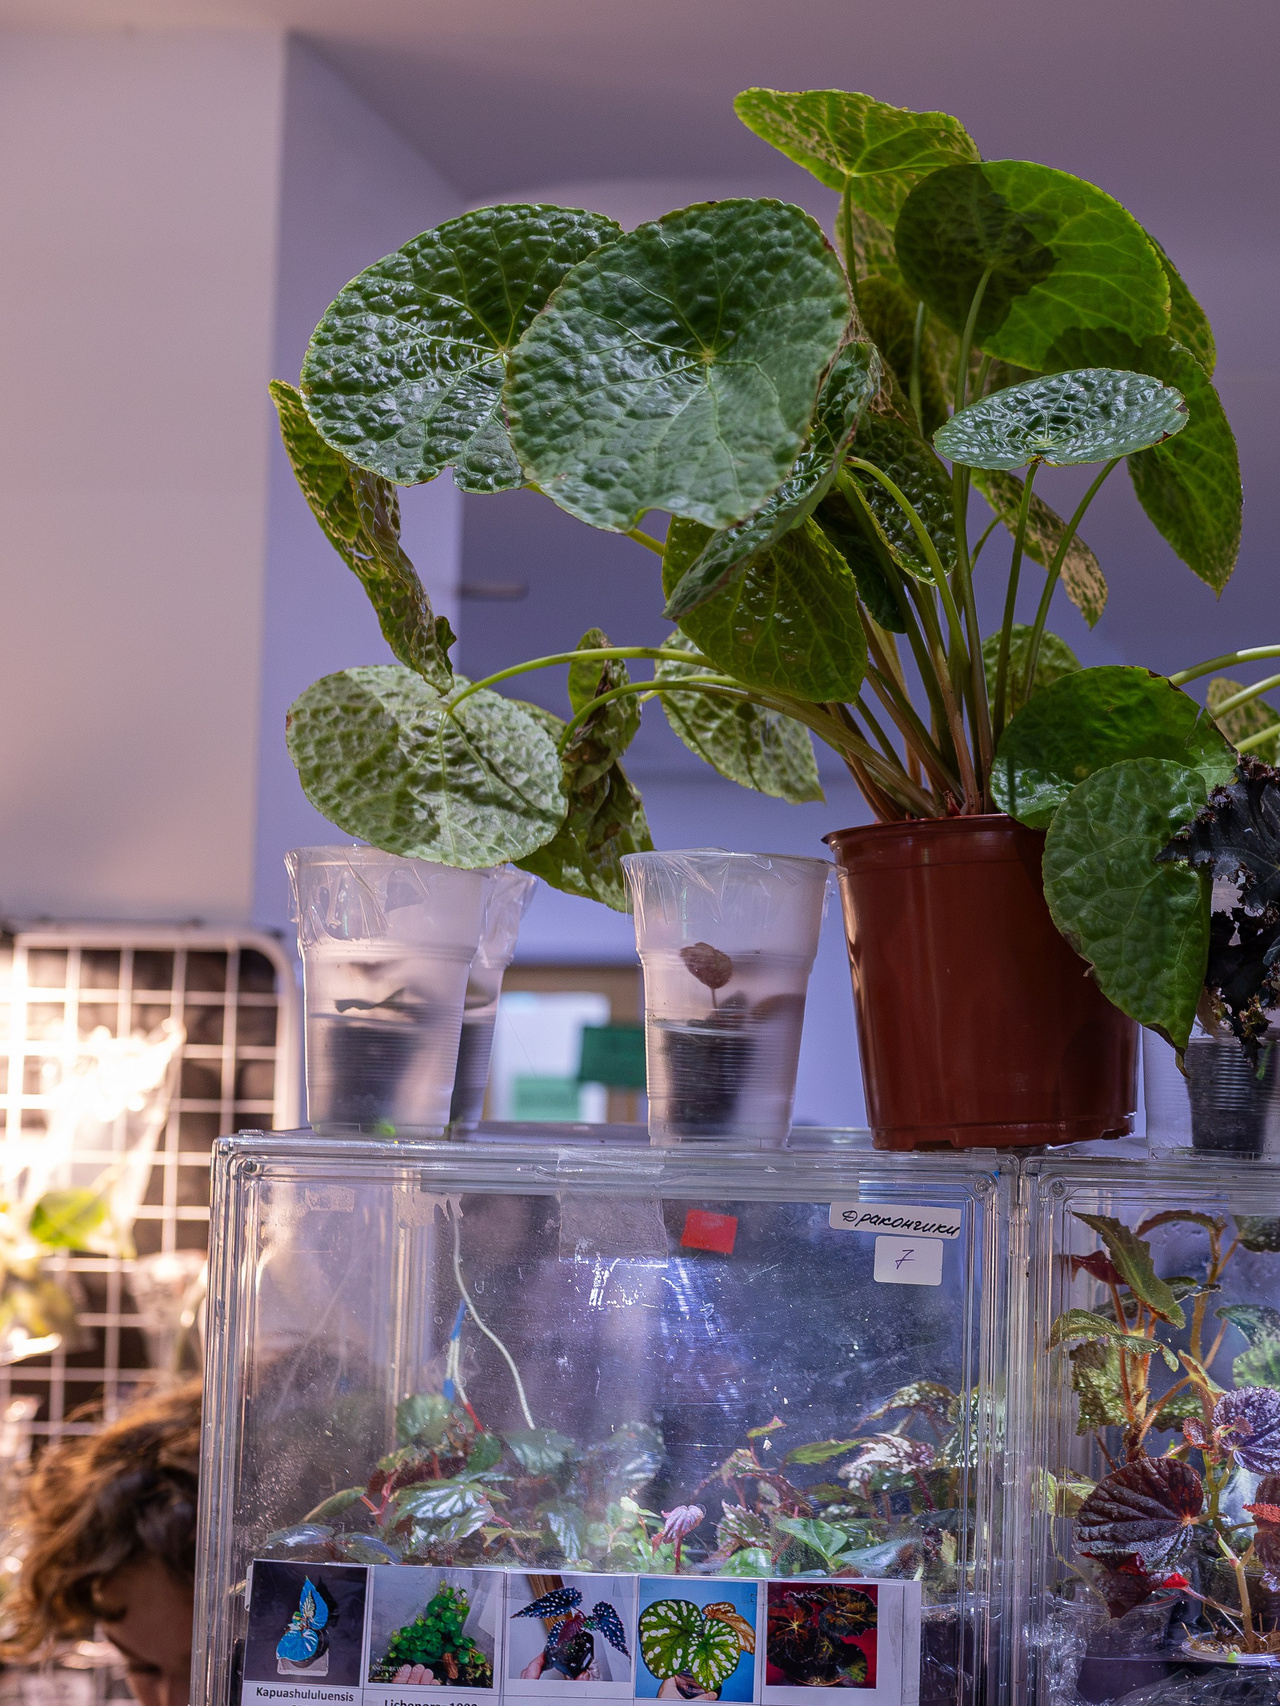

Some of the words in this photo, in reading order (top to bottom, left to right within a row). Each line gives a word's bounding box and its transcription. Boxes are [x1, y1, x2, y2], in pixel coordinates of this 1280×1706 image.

[842, 1210, 961, 1237] Дракончики
[894, 1249, 916, 1270] 7
[256, 1687, 354, 1702] Kapuashululuensis
